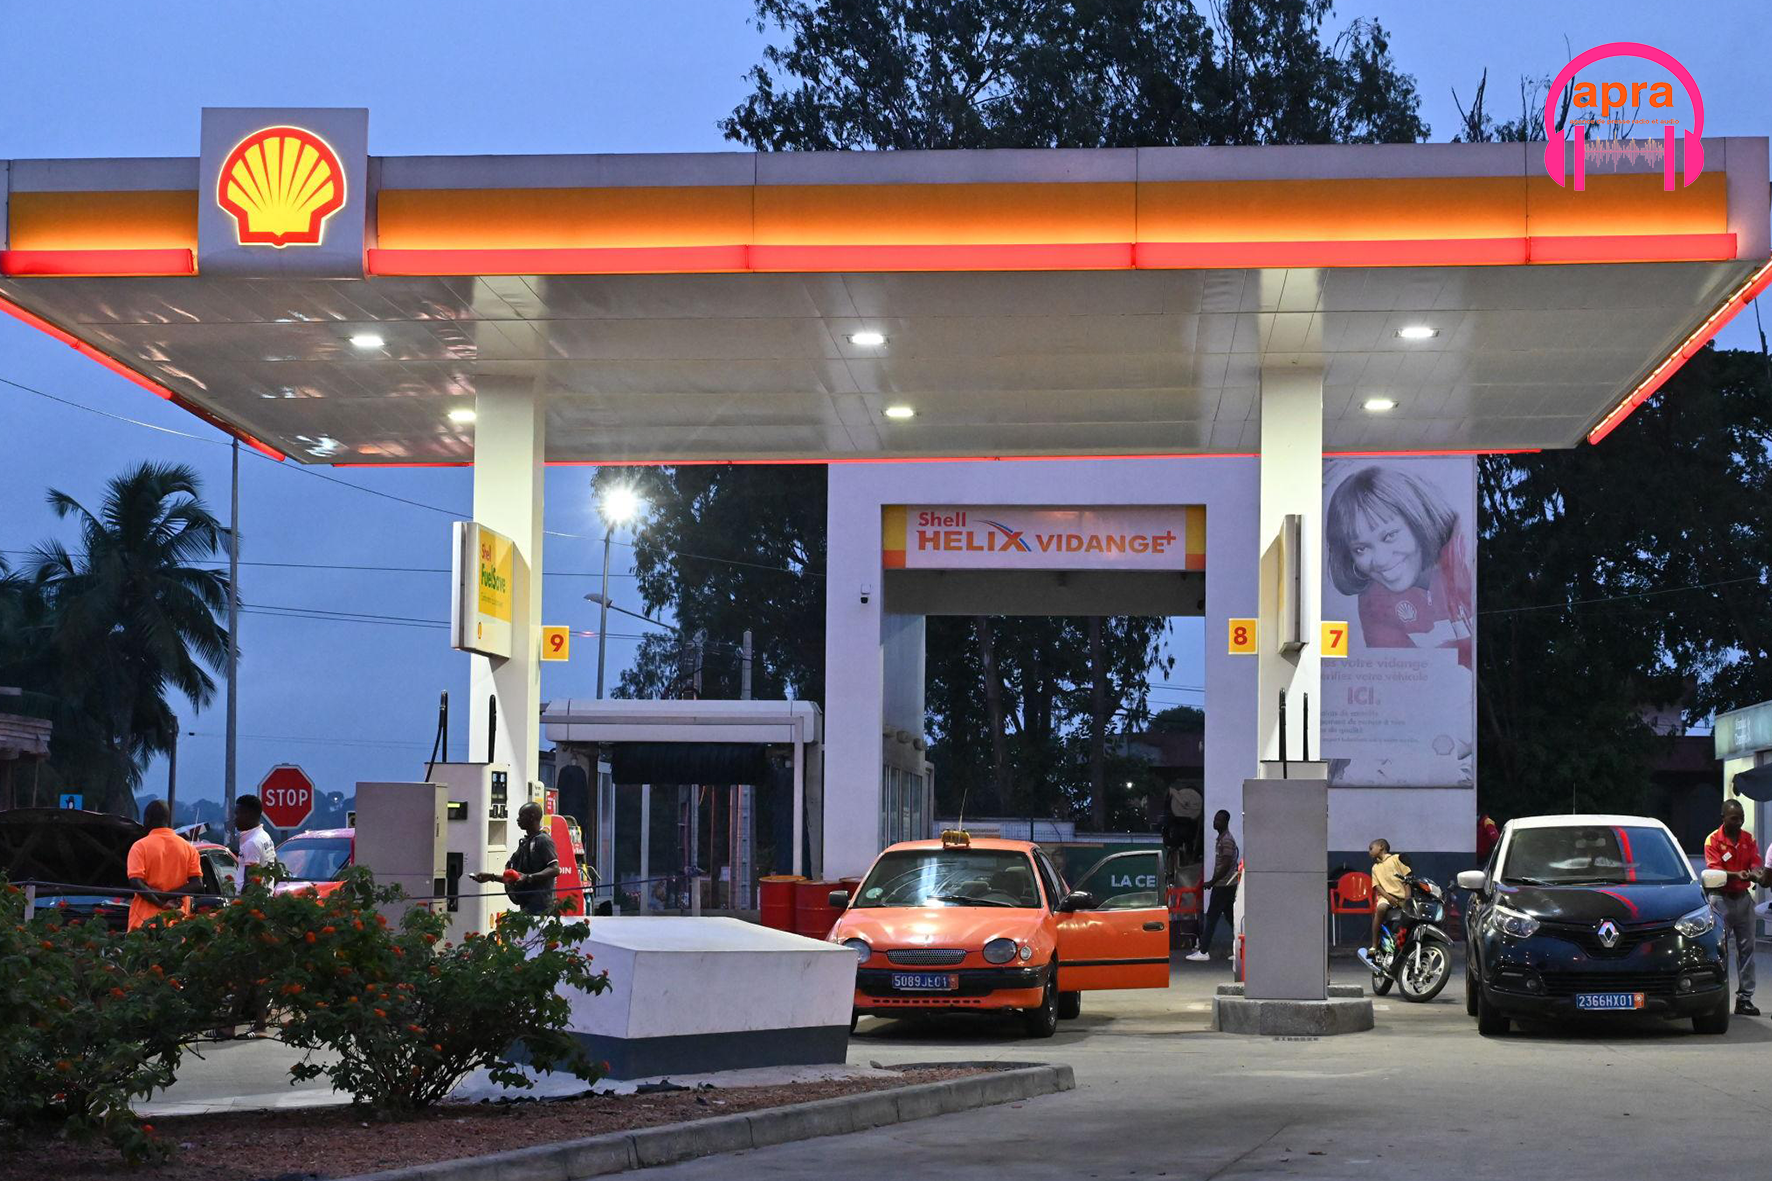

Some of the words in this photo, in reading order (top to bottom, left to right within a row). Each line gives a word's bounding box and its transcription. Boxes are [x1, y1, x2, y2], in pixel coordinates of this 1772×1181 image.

[918, 511, 966, 527] Shell
[916, 530, 1028, 552] HELIX
[550, 634, 565, 652] 9
[1233, 626, 1248, 646] 8
[1329, 629, 1344, 648] 7
[265, 789, 309, 807] STOP
[1111, 874, 1133, 887] LA
[1135, 874, 1158, 887] CE
[894, 975, 947, 987] 5089JE01
[1578, 995, 1633, 1007] 2366HX01
